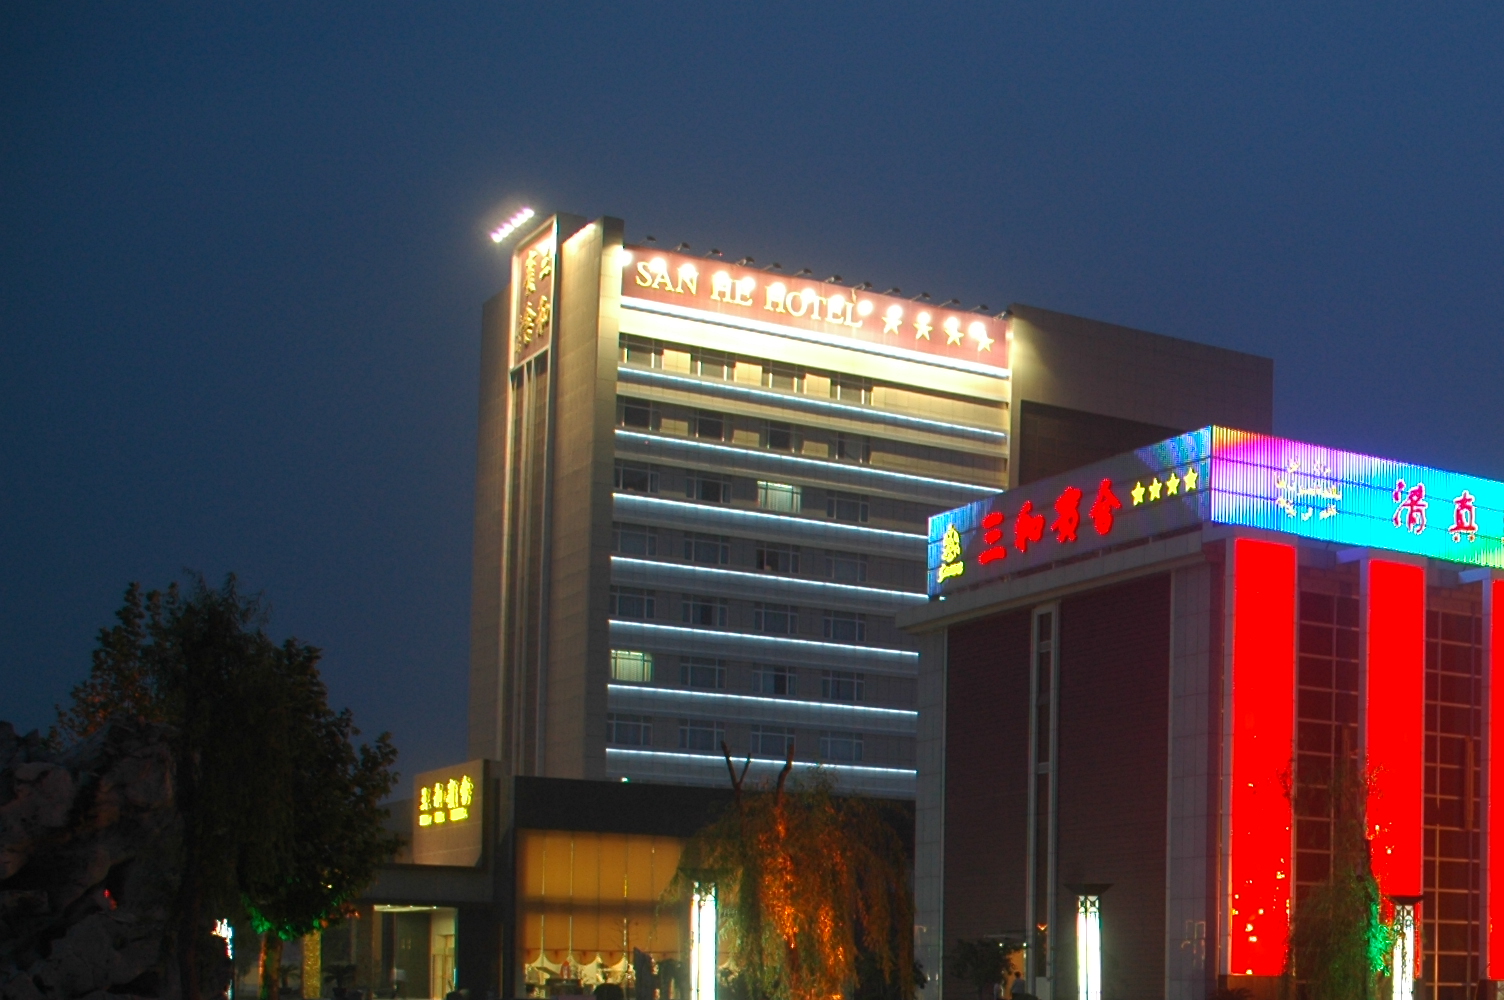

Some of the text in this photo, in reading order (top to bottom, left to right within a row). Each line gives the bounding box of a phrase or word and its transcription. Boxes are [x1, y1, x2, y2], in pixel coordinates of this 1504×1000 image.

[635, 260, 863, 328] SAN HE HOTEL
